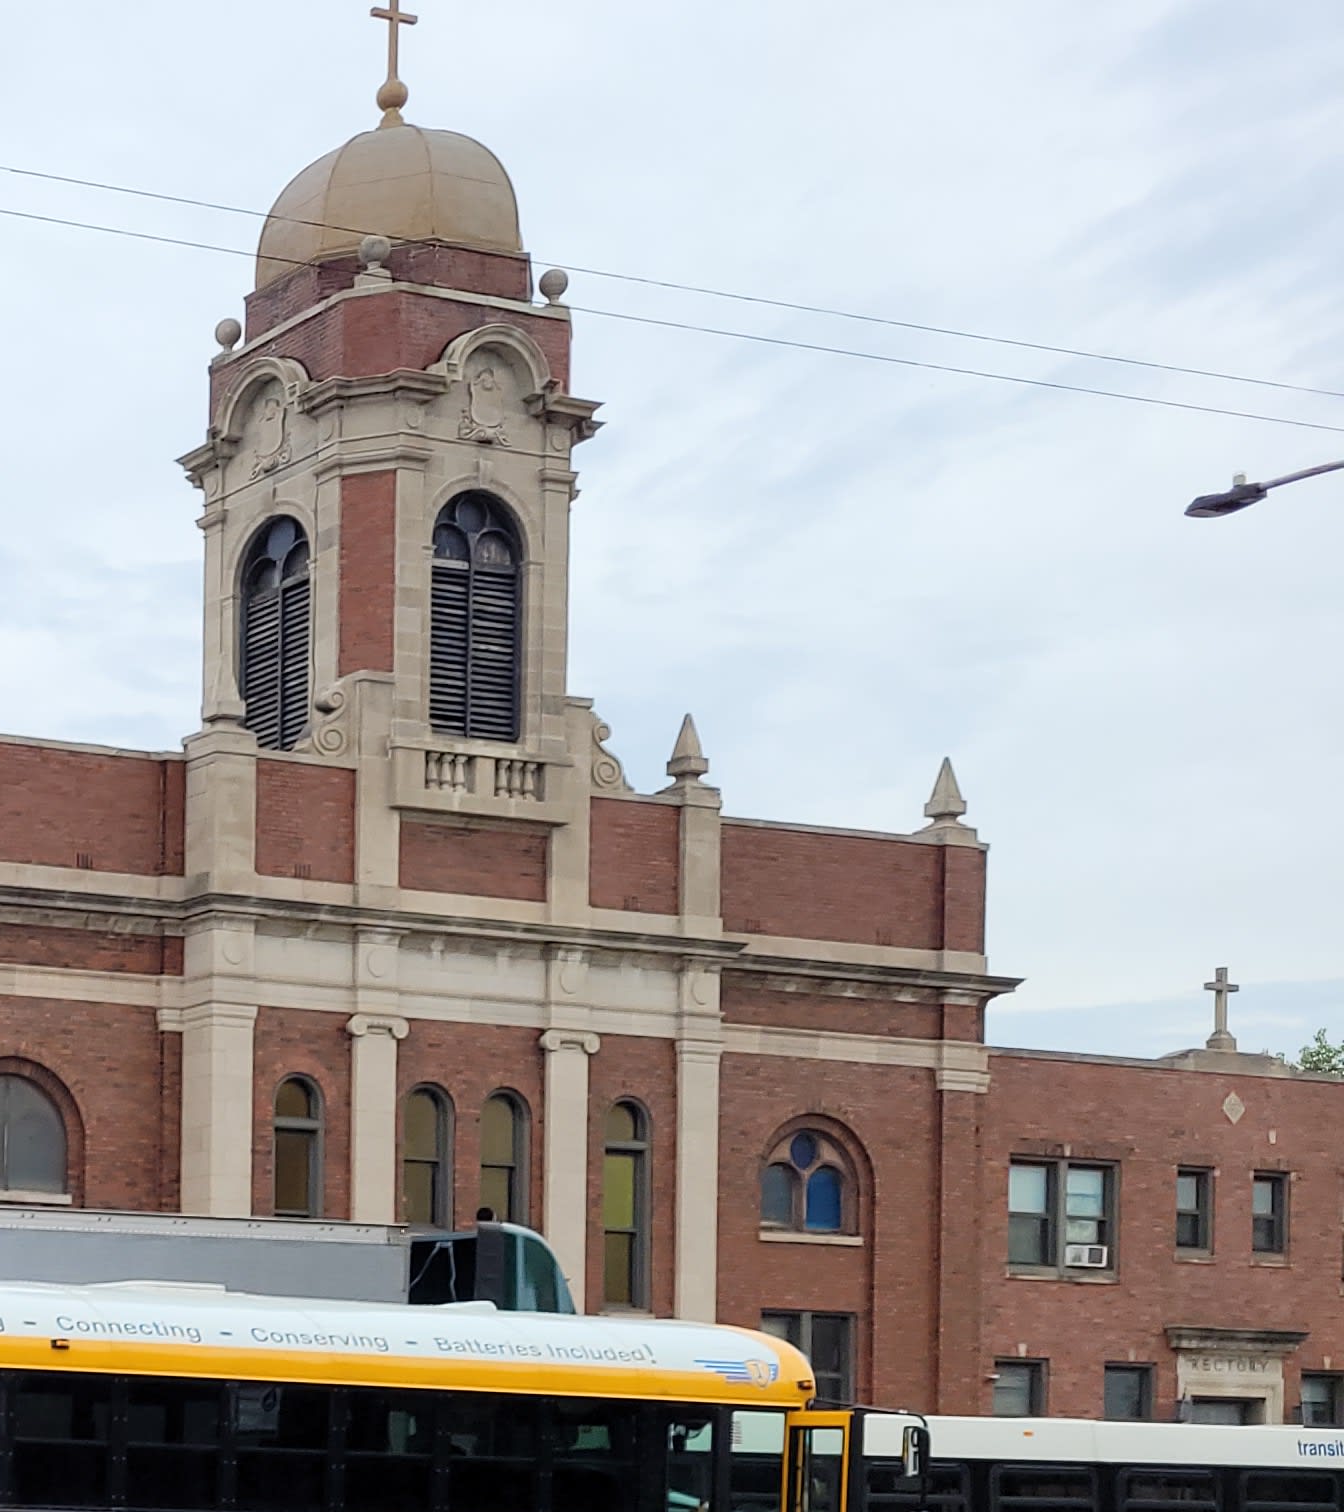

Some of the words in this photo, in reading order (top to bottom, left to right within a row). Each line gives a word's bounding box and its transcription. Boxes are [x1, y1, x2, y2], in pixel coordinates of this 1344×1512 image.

[56, 1316, 202, 1343] Connecting
[250, 1327, 389, 1352] Conserving
[433, 1337, 543, 1358] Batteries
[547, 1343, 658, 1365] Included!
[1190, 1357, 1271, 1374] RECTORY
